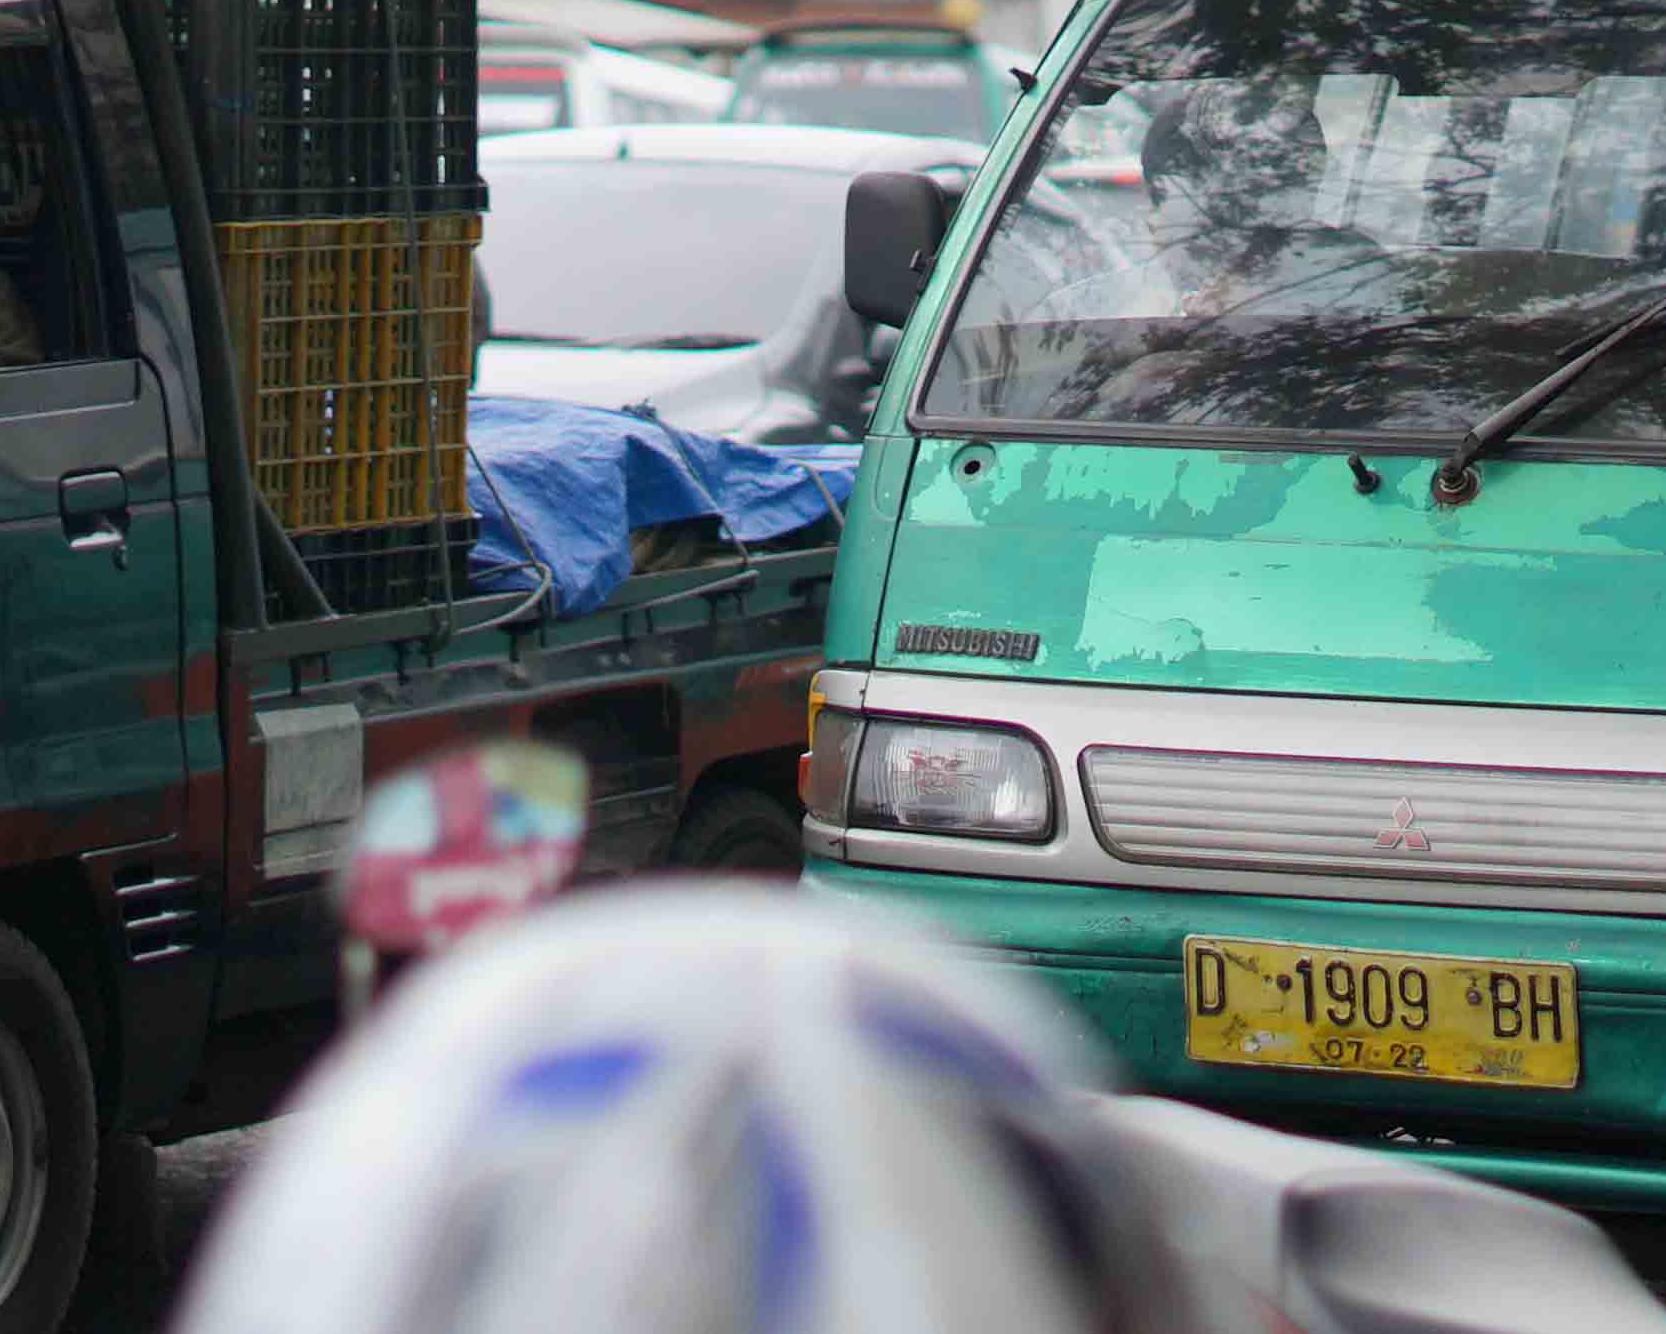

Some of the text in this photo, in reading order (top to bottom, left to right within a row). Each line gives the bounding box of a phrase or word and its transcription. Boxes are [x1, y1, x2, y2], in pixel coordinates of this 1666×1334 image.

[896, 622, 1040, 660] MITSUBISHI
[1195, 945, 1563, 1043] D 1909 BH
